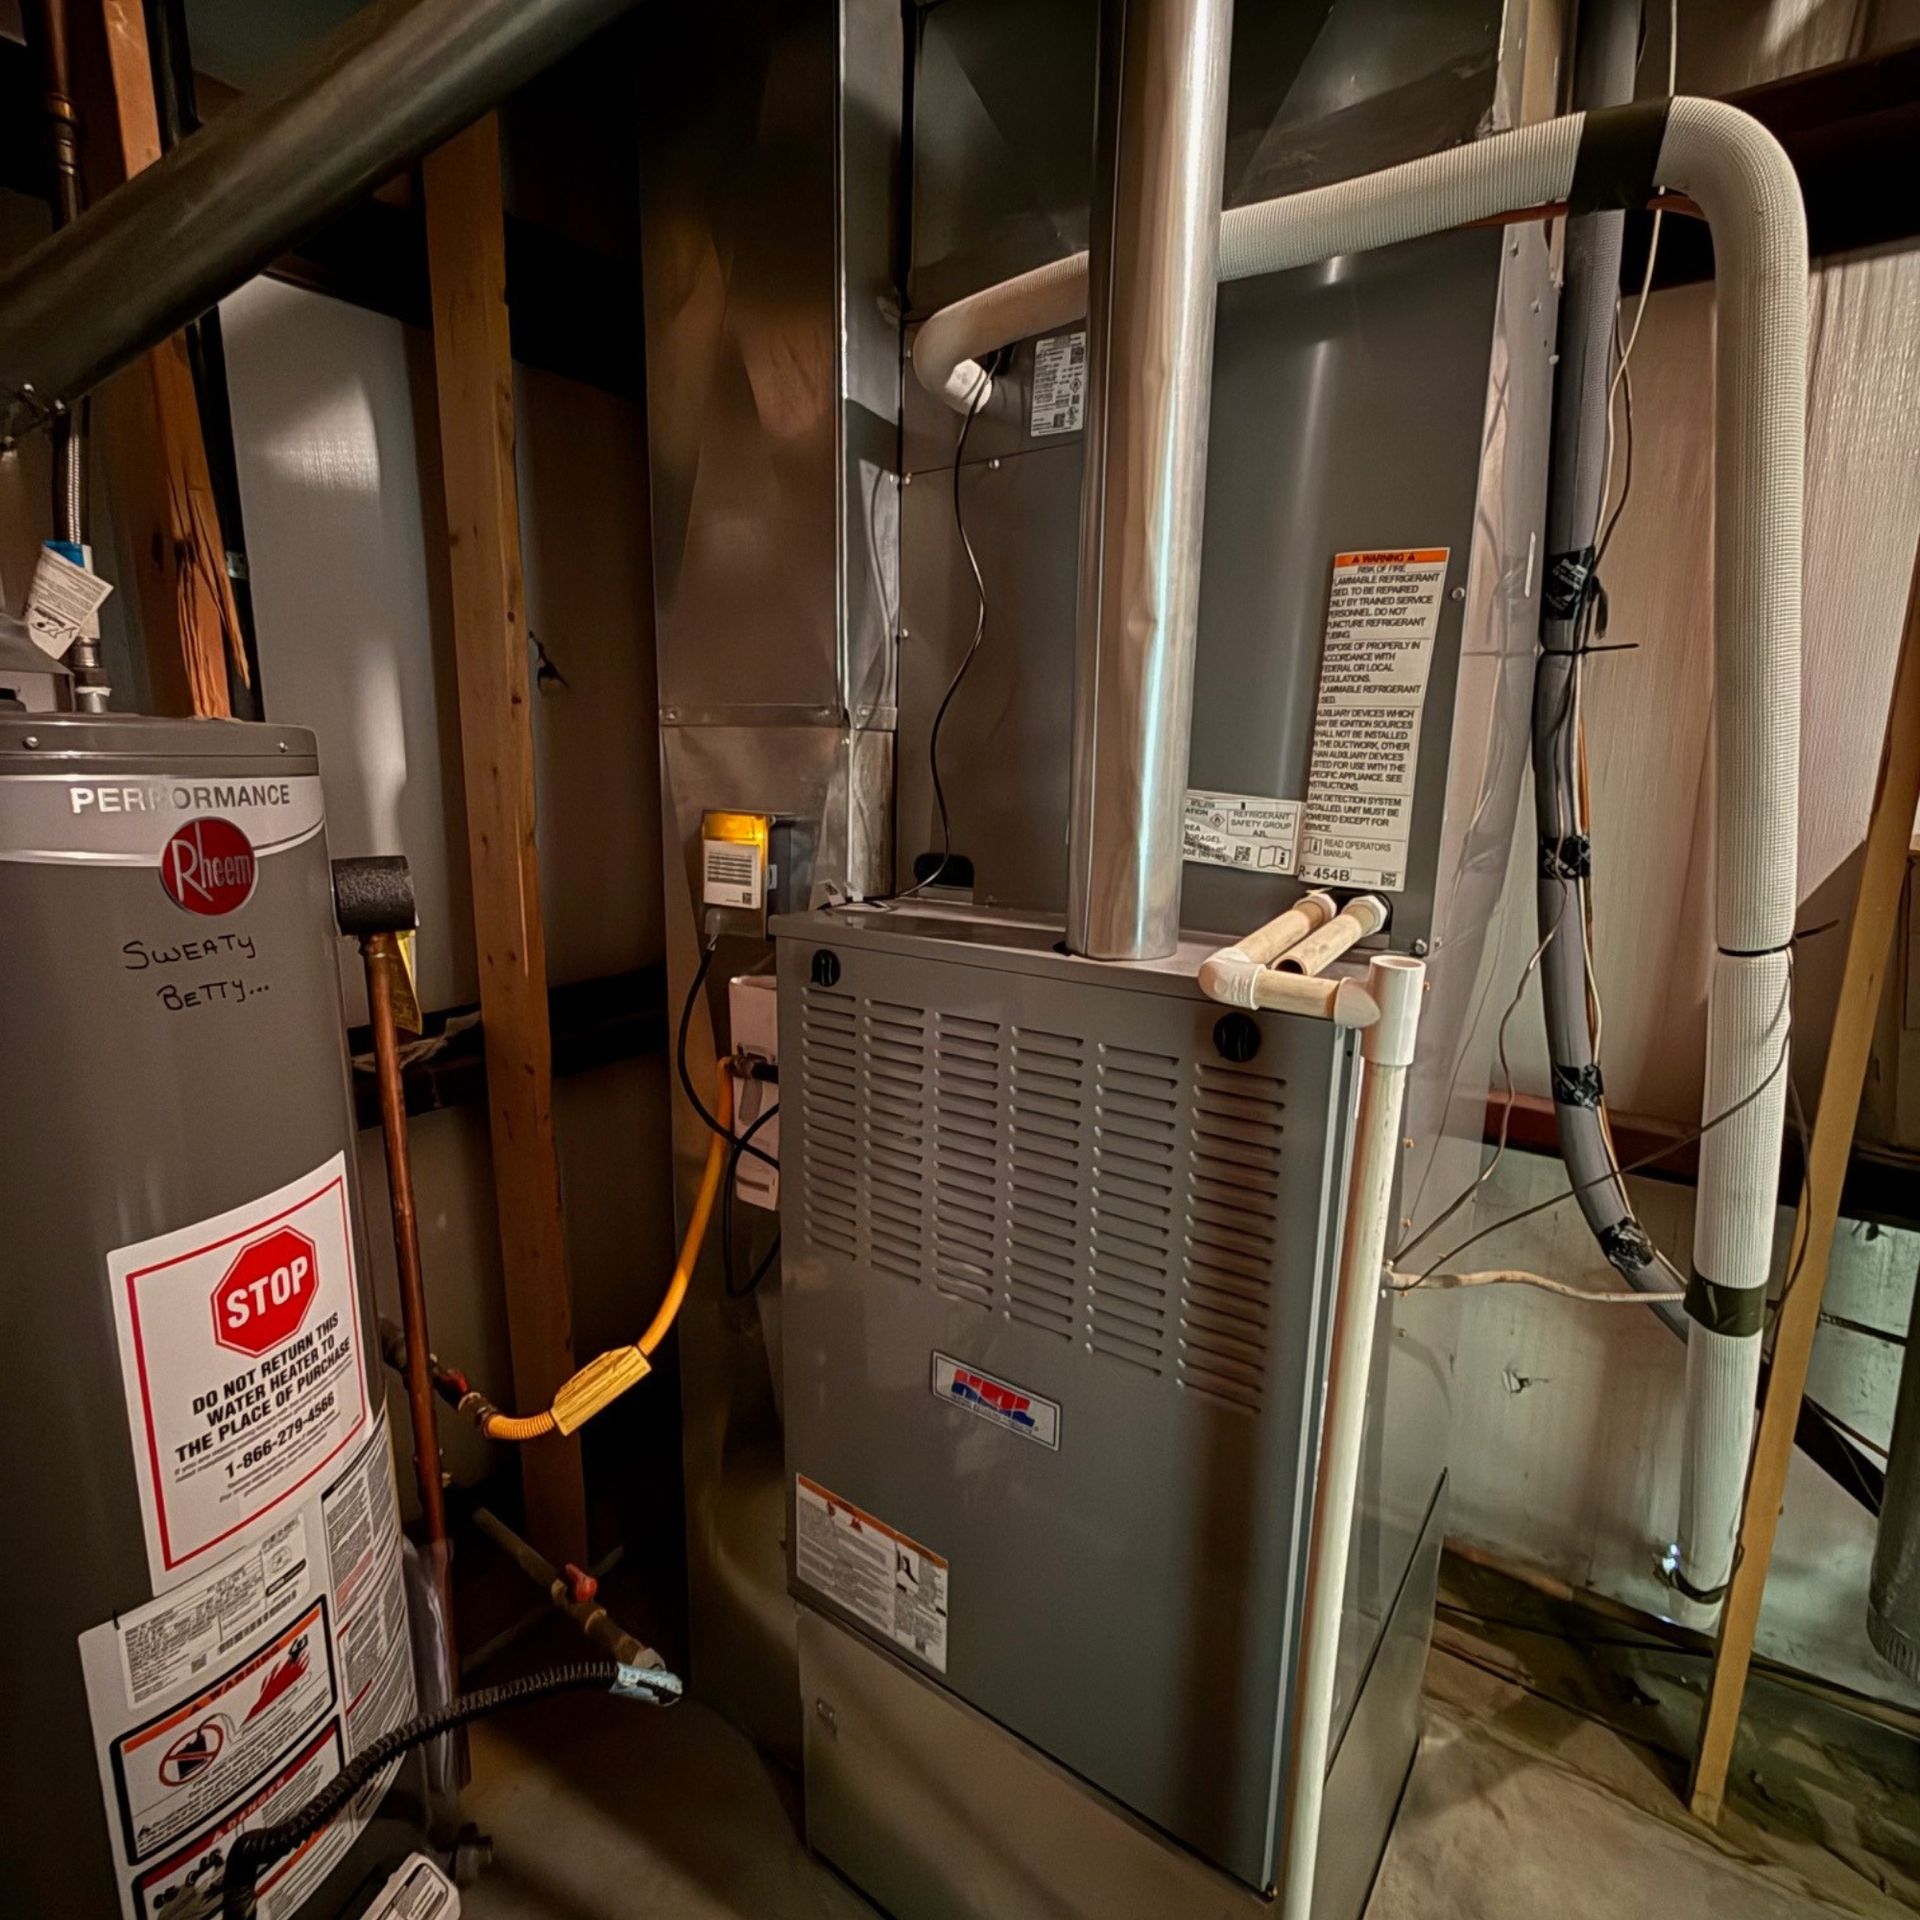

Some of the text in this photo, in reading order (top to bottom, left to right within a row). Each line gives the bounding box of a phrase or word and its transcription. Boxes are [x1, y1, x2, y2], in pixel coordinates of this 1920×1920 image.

[1362, 554, 1404, 562] WARNING
[1379, 573, 1440, 584] REFRIGERANT
[1351, 586, 1362, 595] TO
[1363, 586, 1374, 594] BE
[1376, 585, 1419, 594] REPAIRED
[1347, 598, 1358, 606] BY
[1360, 596, 1395, 605] TRAINED
[1396, 595, 1433, 604] SERVICE
[1374, 608, 1387, 616] DO
[1389, 607, 1408, 615] NOT
[1366, 617, 1426, 627] REFRIGERANT
[1354, 642, 1365, 650] OF
[1366, 641, 1410, 650] PROPERLY
[1412, 641, 1420, 650] IN
[1374, 652, 1396, 661] WITH
[1353, 663, 1365, 672] OR
[1366, 663, 1394, 672] LOCAL
[1362, 684, 1421, 693] REFRIGERANT
[1386, 710, 1415, 718] WHICH
[1329, 720, 1338, 728] BE
[1373, 721, 1413, 729] SOURCES
[1364, 731, 1408, 740] INSTALLED
[1320, 740, 1332, 748] THE
[1380, 742, 1410, 751] OTHER
[1330, 751, 1367, 760] AUXILIARY
[1369, 752, 1404, 761] DEVICES
[1333, 761, 1349, 769] FOR
[1350, 762, 1365, 770] USE
[1367, 763, 1388, 771] WITH
[1389, 764, 1406, 773] THE
[1385, 775, 1403, 783] SEE
[1324, 794, 1366, 804] DETECTION
[1367, 797, 1402, 806] SYSTEM
[1344, 805, 1362, 814] UNIT
[1363, 807, 1385, 816] MUST
[1387, 809, 1399, 817] BE
[1231, 820, 1292, 829] SAFETY GROUP
[1339, 815, 1370, 825] EXCEPT
[1371, 818, 1389, 826] FOR
[1324, 838, 1391, 852] READ OPERATORS
[1323, 849, 1352, 860] MANUAL
[172, 822, 250, 901] Rheem
[226, 1256, 308, 1329] STOP
[192, 1312, 338, 1416] DO NOT RETURN THIS
[206, 1334, 335, 1427] WATER HEATER TO
[175, 1336, 350, 1463] THE PLACE OF PURCHASE
